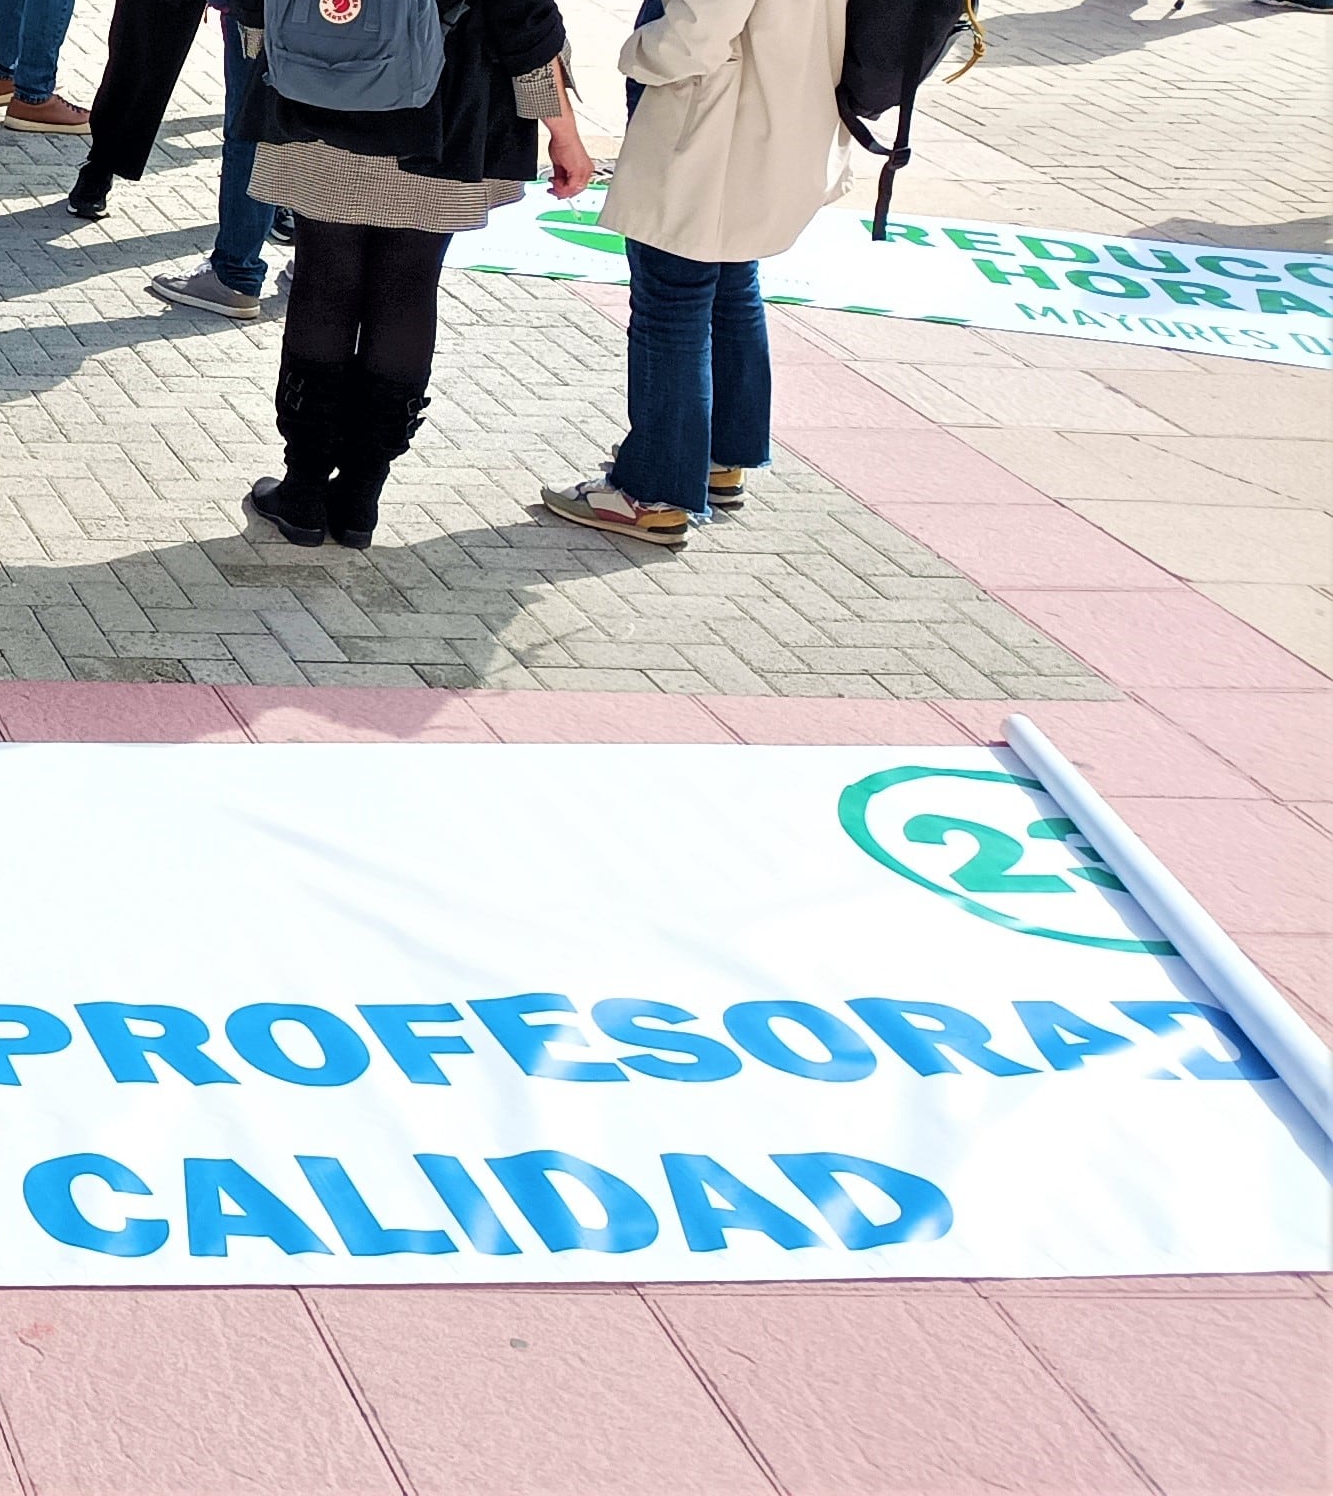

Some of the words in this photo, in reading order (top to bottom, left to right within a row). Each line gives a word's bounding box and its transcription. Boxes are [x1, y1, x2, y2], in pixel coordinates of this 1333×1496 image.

[972, 258, 1333, 319] HORA
[1015, 302, 1280, 350] MAYORES
[1288, 332, 1333, 356] D
[22, 1149, 954, 1257] CALIDAD
